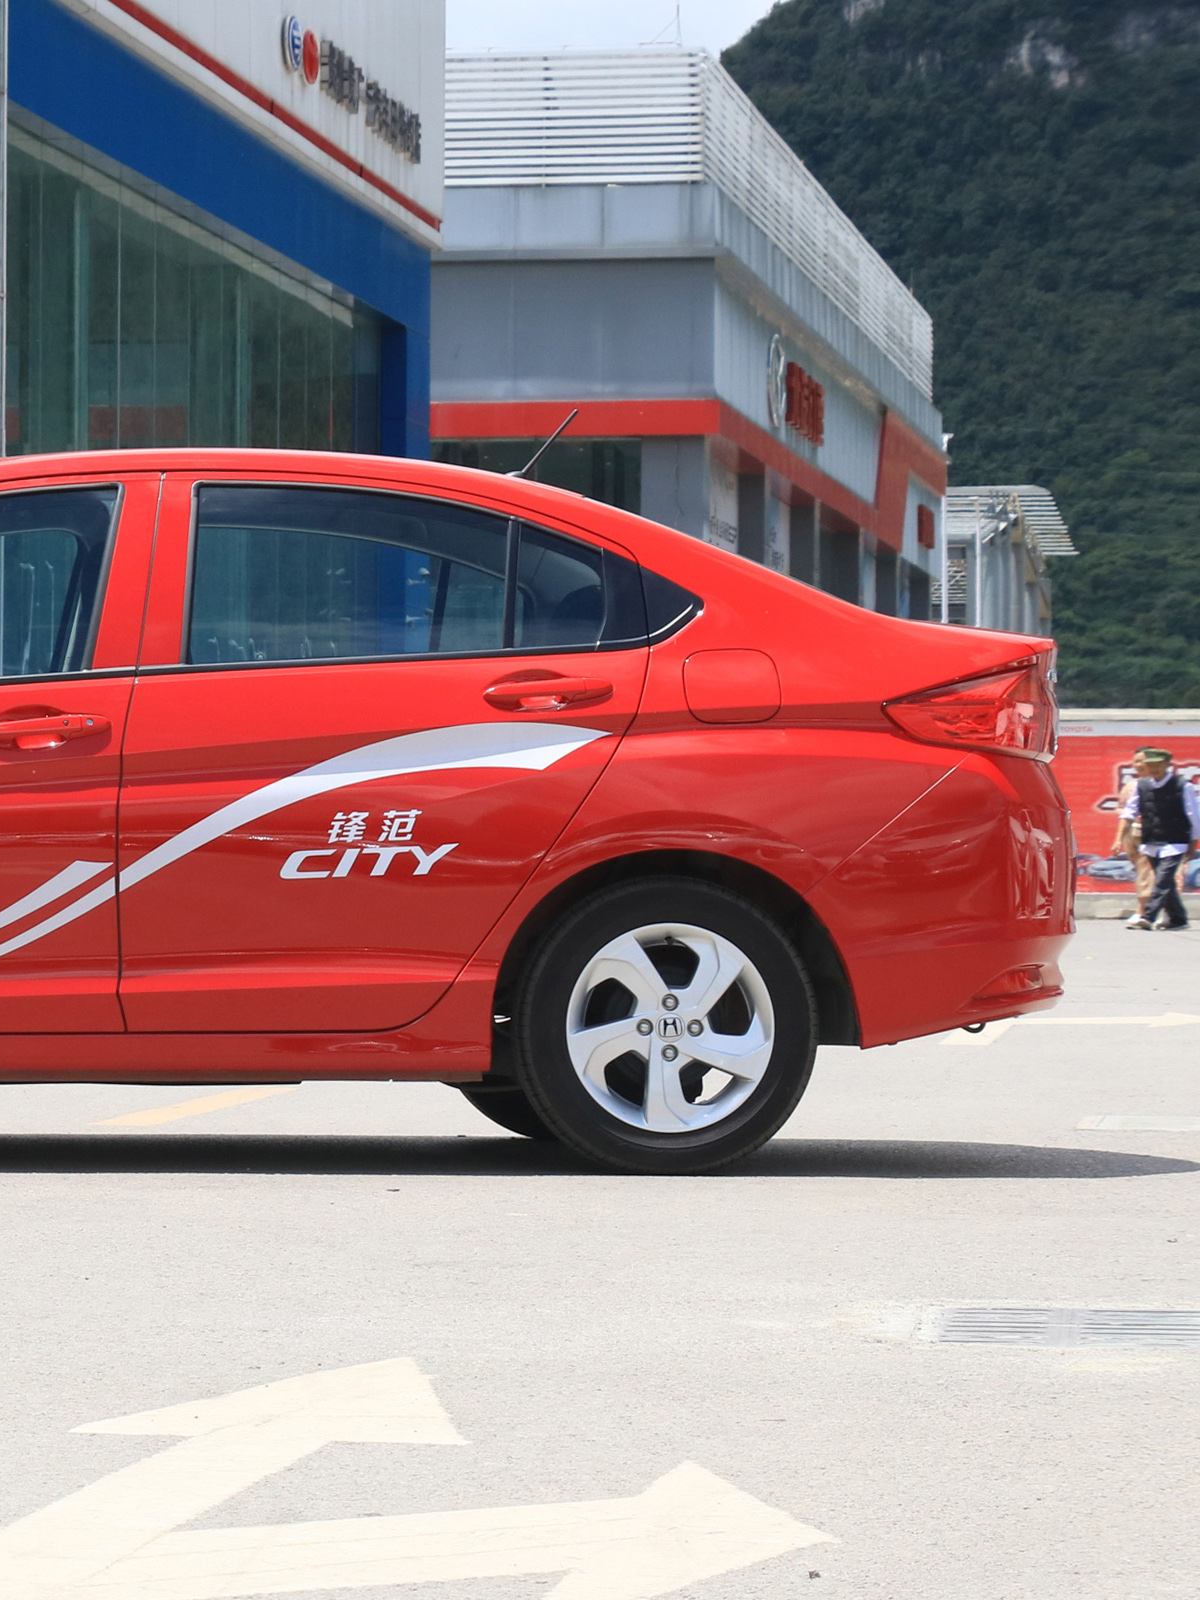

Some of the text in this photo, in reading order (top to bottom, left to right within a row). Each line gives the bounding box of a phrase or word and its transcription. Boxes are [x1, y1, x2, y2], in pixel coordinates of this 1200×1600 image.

[1060, 725, 1094, 733] TOYOTA
[327, 808, 423, 844] 锋范
[279, 842, 460, 880] CITY
